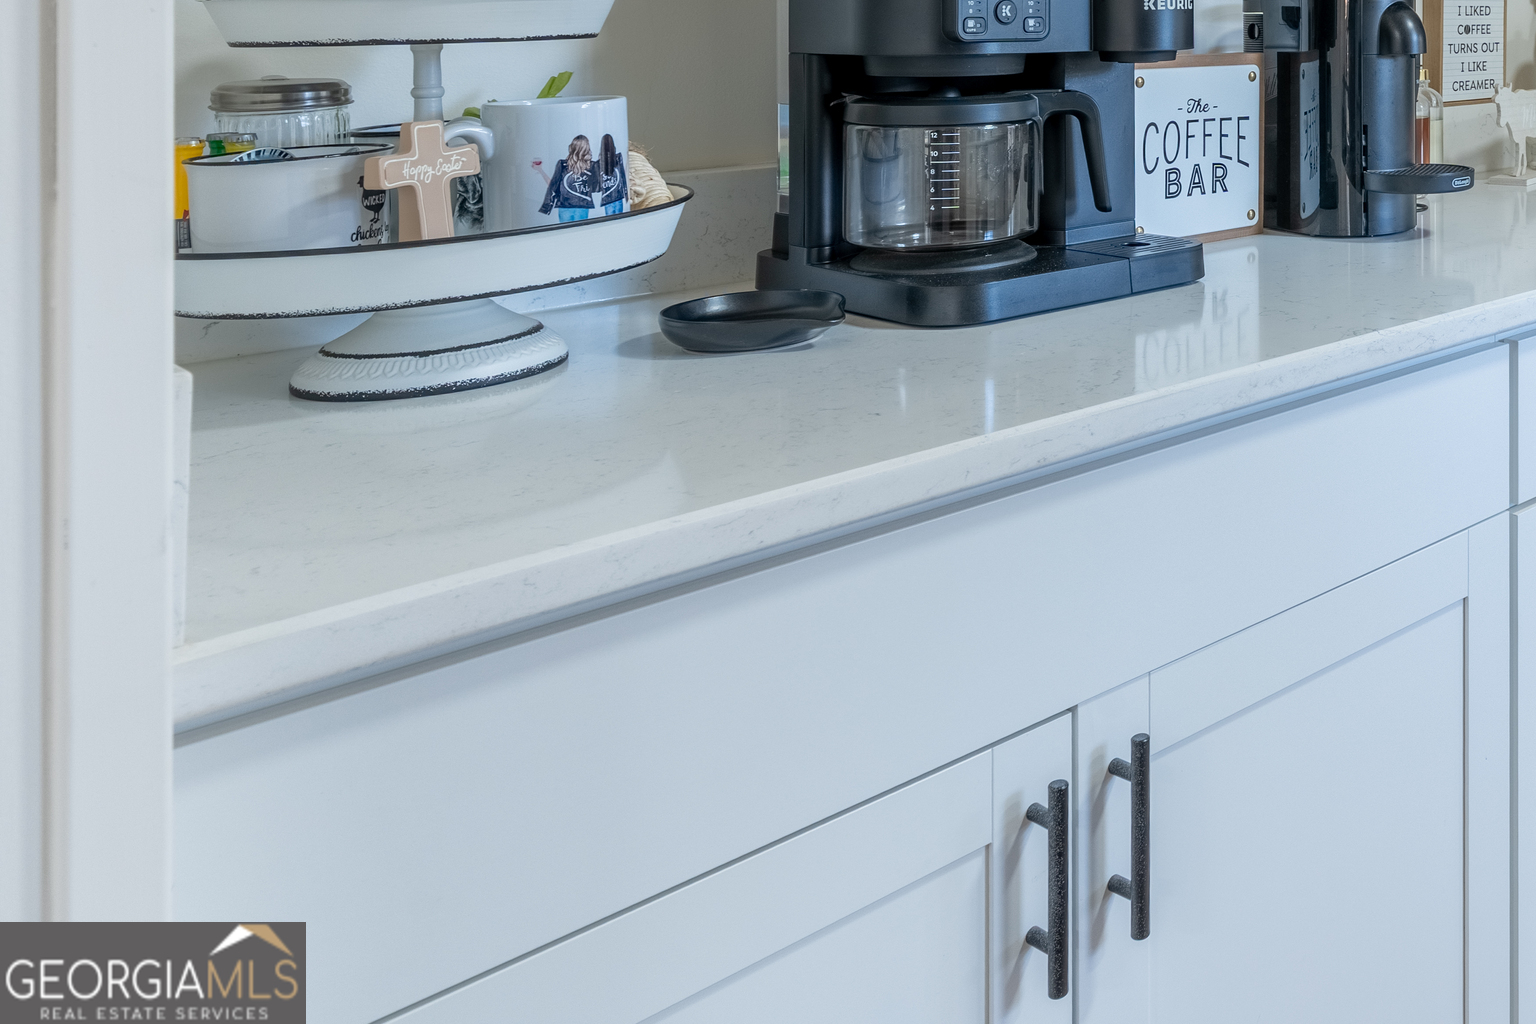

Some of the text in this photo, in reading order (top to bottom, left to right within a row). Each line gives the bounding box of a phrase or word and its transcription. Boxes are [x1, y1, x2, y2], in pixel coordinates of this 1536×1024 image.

[1457, 5, 1491, 16] I LIKED
[1457, 23, 1491, 36] COFFEE
[1447, 42, 1500, 55] TURNS OUT
[1460, 61, 1487, 73] I LIKE
[1452, 78, 1496, 92] CREAMER
[1186, 98, 1210, 114] The
[1142, 115, 1250, 175] COFFEE
[402, 154, 467, 184] Happy Easter
[1164, 162, 1229, 200] BAR
[362, 193, 386, 207] WICKED
